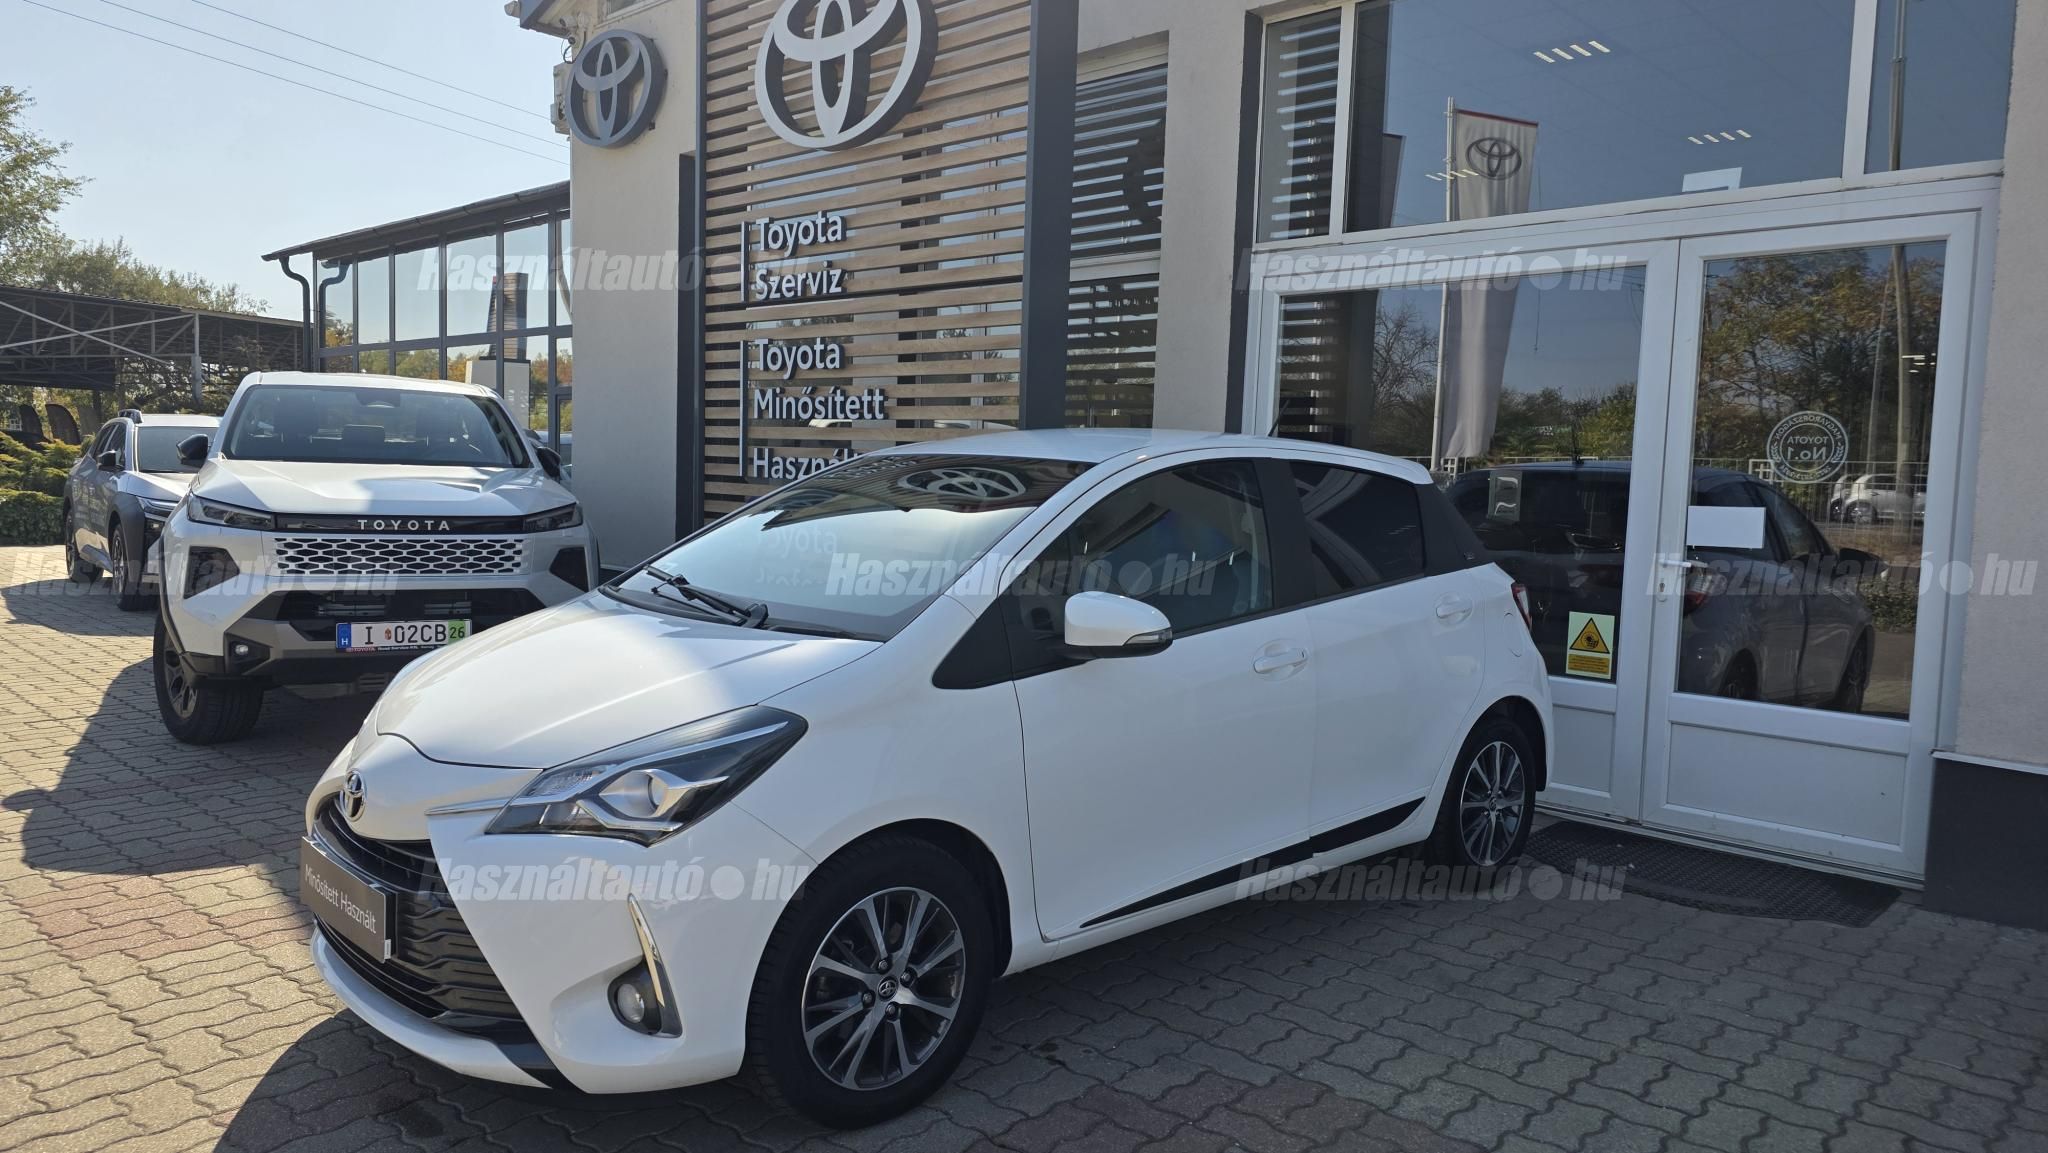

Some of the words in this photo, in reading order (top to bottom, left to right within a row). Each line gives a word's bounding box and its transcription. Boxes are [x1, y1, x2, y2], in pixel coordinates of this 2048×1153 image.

[756, 211, 842, 257] Toyota
[756, 261, 842, 300] Szerviz
[755, 338, 840, 380] Toyota
[754, 387, 885, 420] Minősített
[753, 448, 858, 480] Haszná
[358, 519, 450, 531] TOYOTA
[365, 626, 373, 645] I
[394, 624, 447, 643] 02CB
[449, 626, 465, 639] 26
[340, 891, 376, 934] Használt
